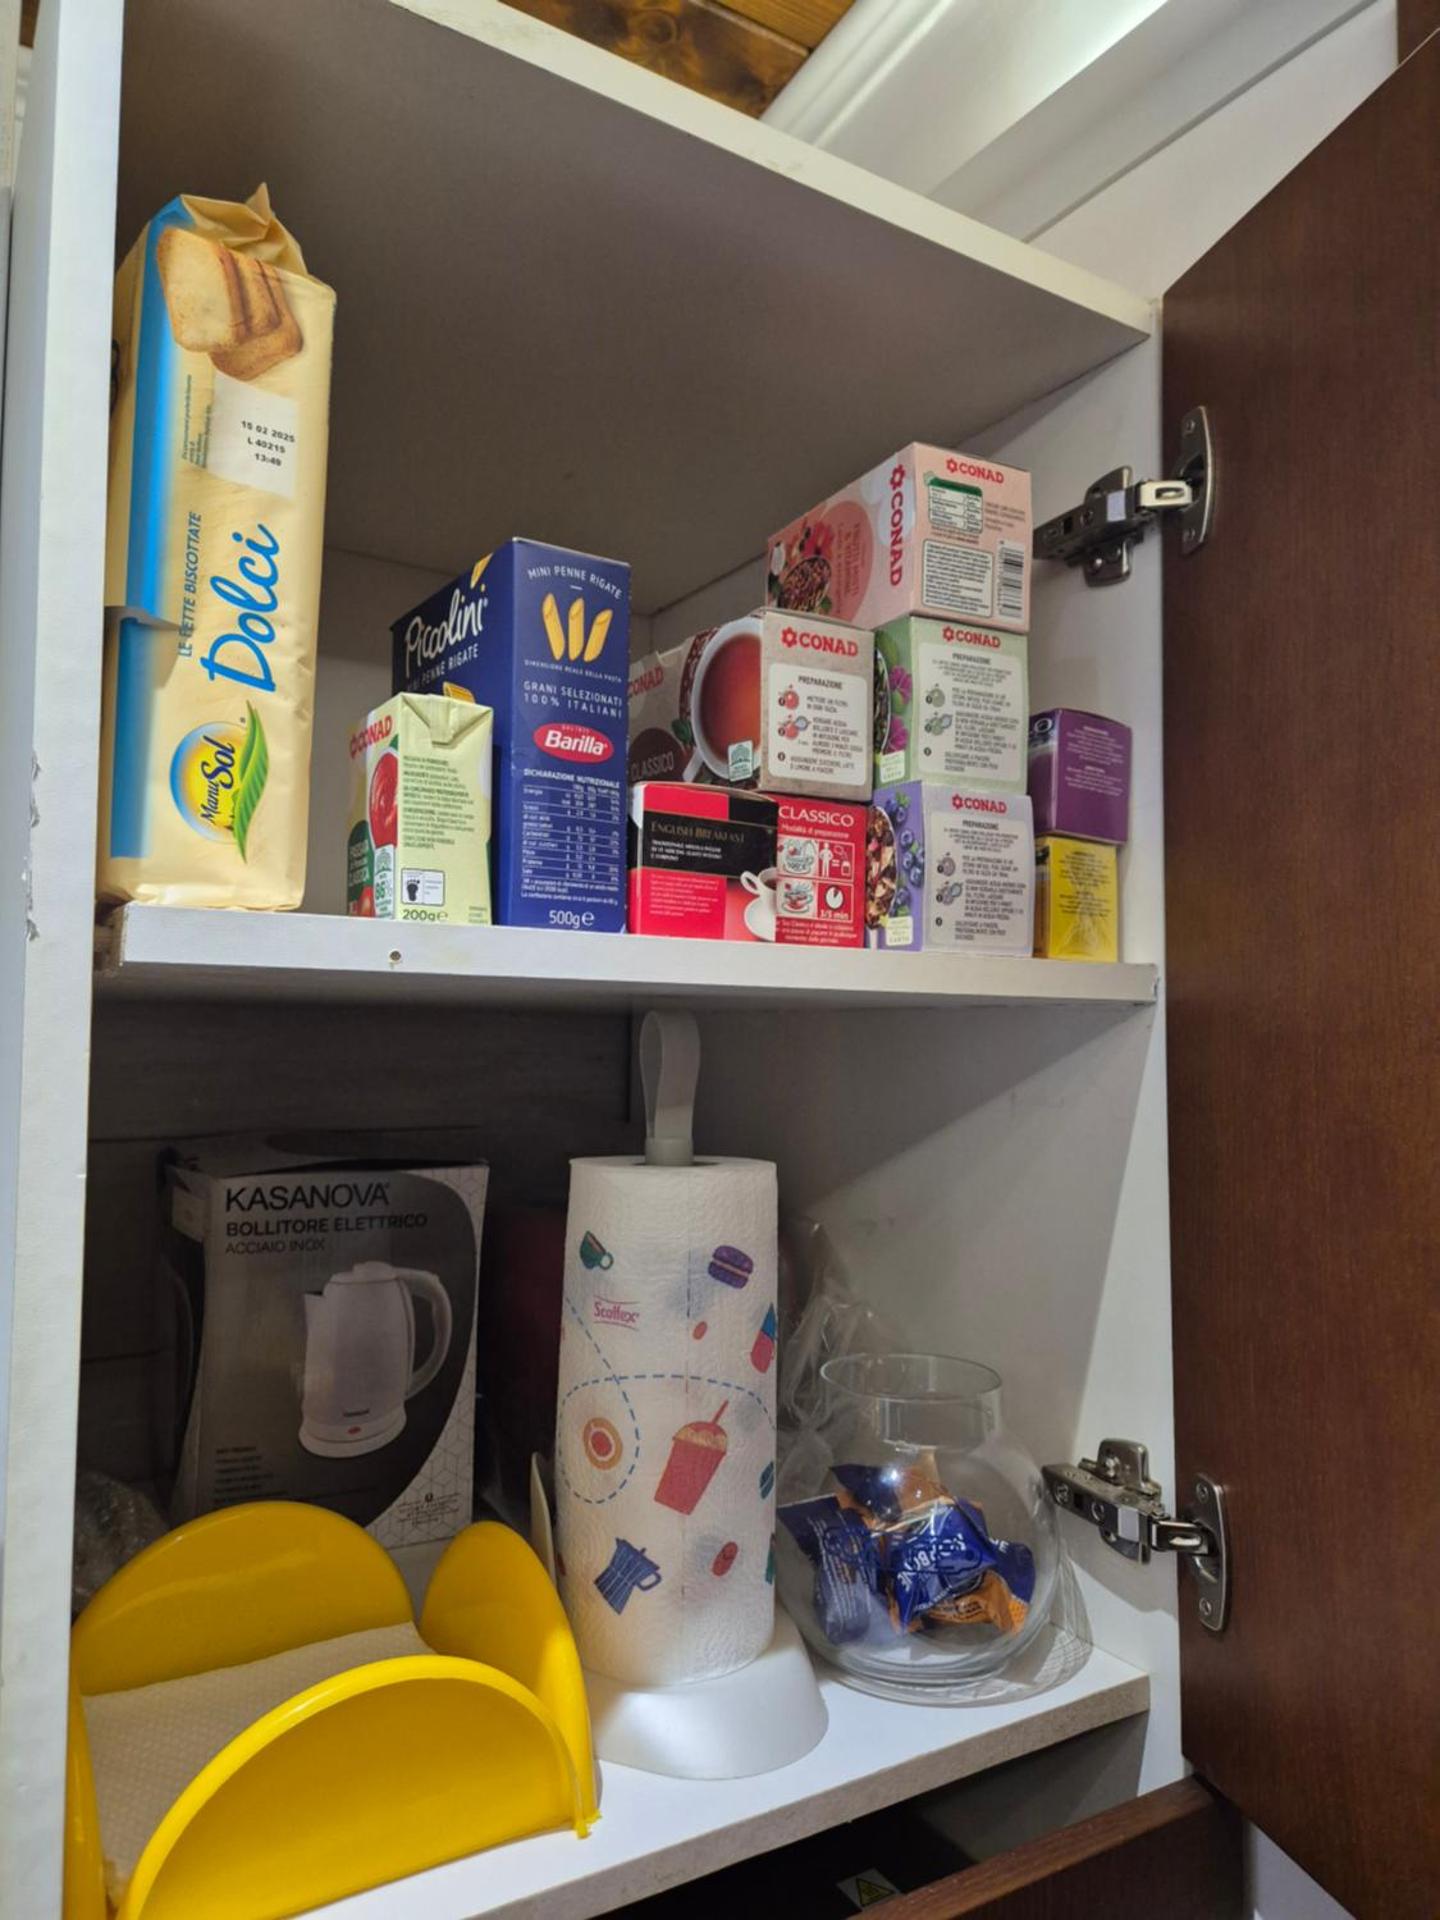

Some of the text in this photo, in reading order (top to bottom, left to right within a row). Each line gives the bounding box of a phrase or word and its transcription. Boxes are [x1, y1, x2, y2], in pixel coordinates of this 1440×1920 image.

[959, 462, 1004, 485] CONAD
[890, 491, 904, 586] CONAD
[183, 511, 202, 595] BISCOTTATE
[527, 565, 623, 599] MINI PENNE RIGATE
[200, 523, 280, 692] Dolci
[404, 583, 488, 679] Piccolini
[955, 630, 1001, 648] CONAD
[178, 642, 193, 657] LE
[799, 632, 859, 657] CONAD
[523, 680, 623, 707] GRANI SELEZIONATI
[523, 692, 623, 719] 100% ITALIANI
[544, 729, 606, 756] Barilla
[778, 805, 855, 828] CLASSICO
[964, 797, 1007, 814] CONAD
[549, 909, 580, 929] 500g
[225, 1182, 390, 1213] KASANOVA
[226, 1212, 428, 1237] BOLLITORE ELETTRICO
[225, 1237, 326, 1255] ACCIAIO INOX
